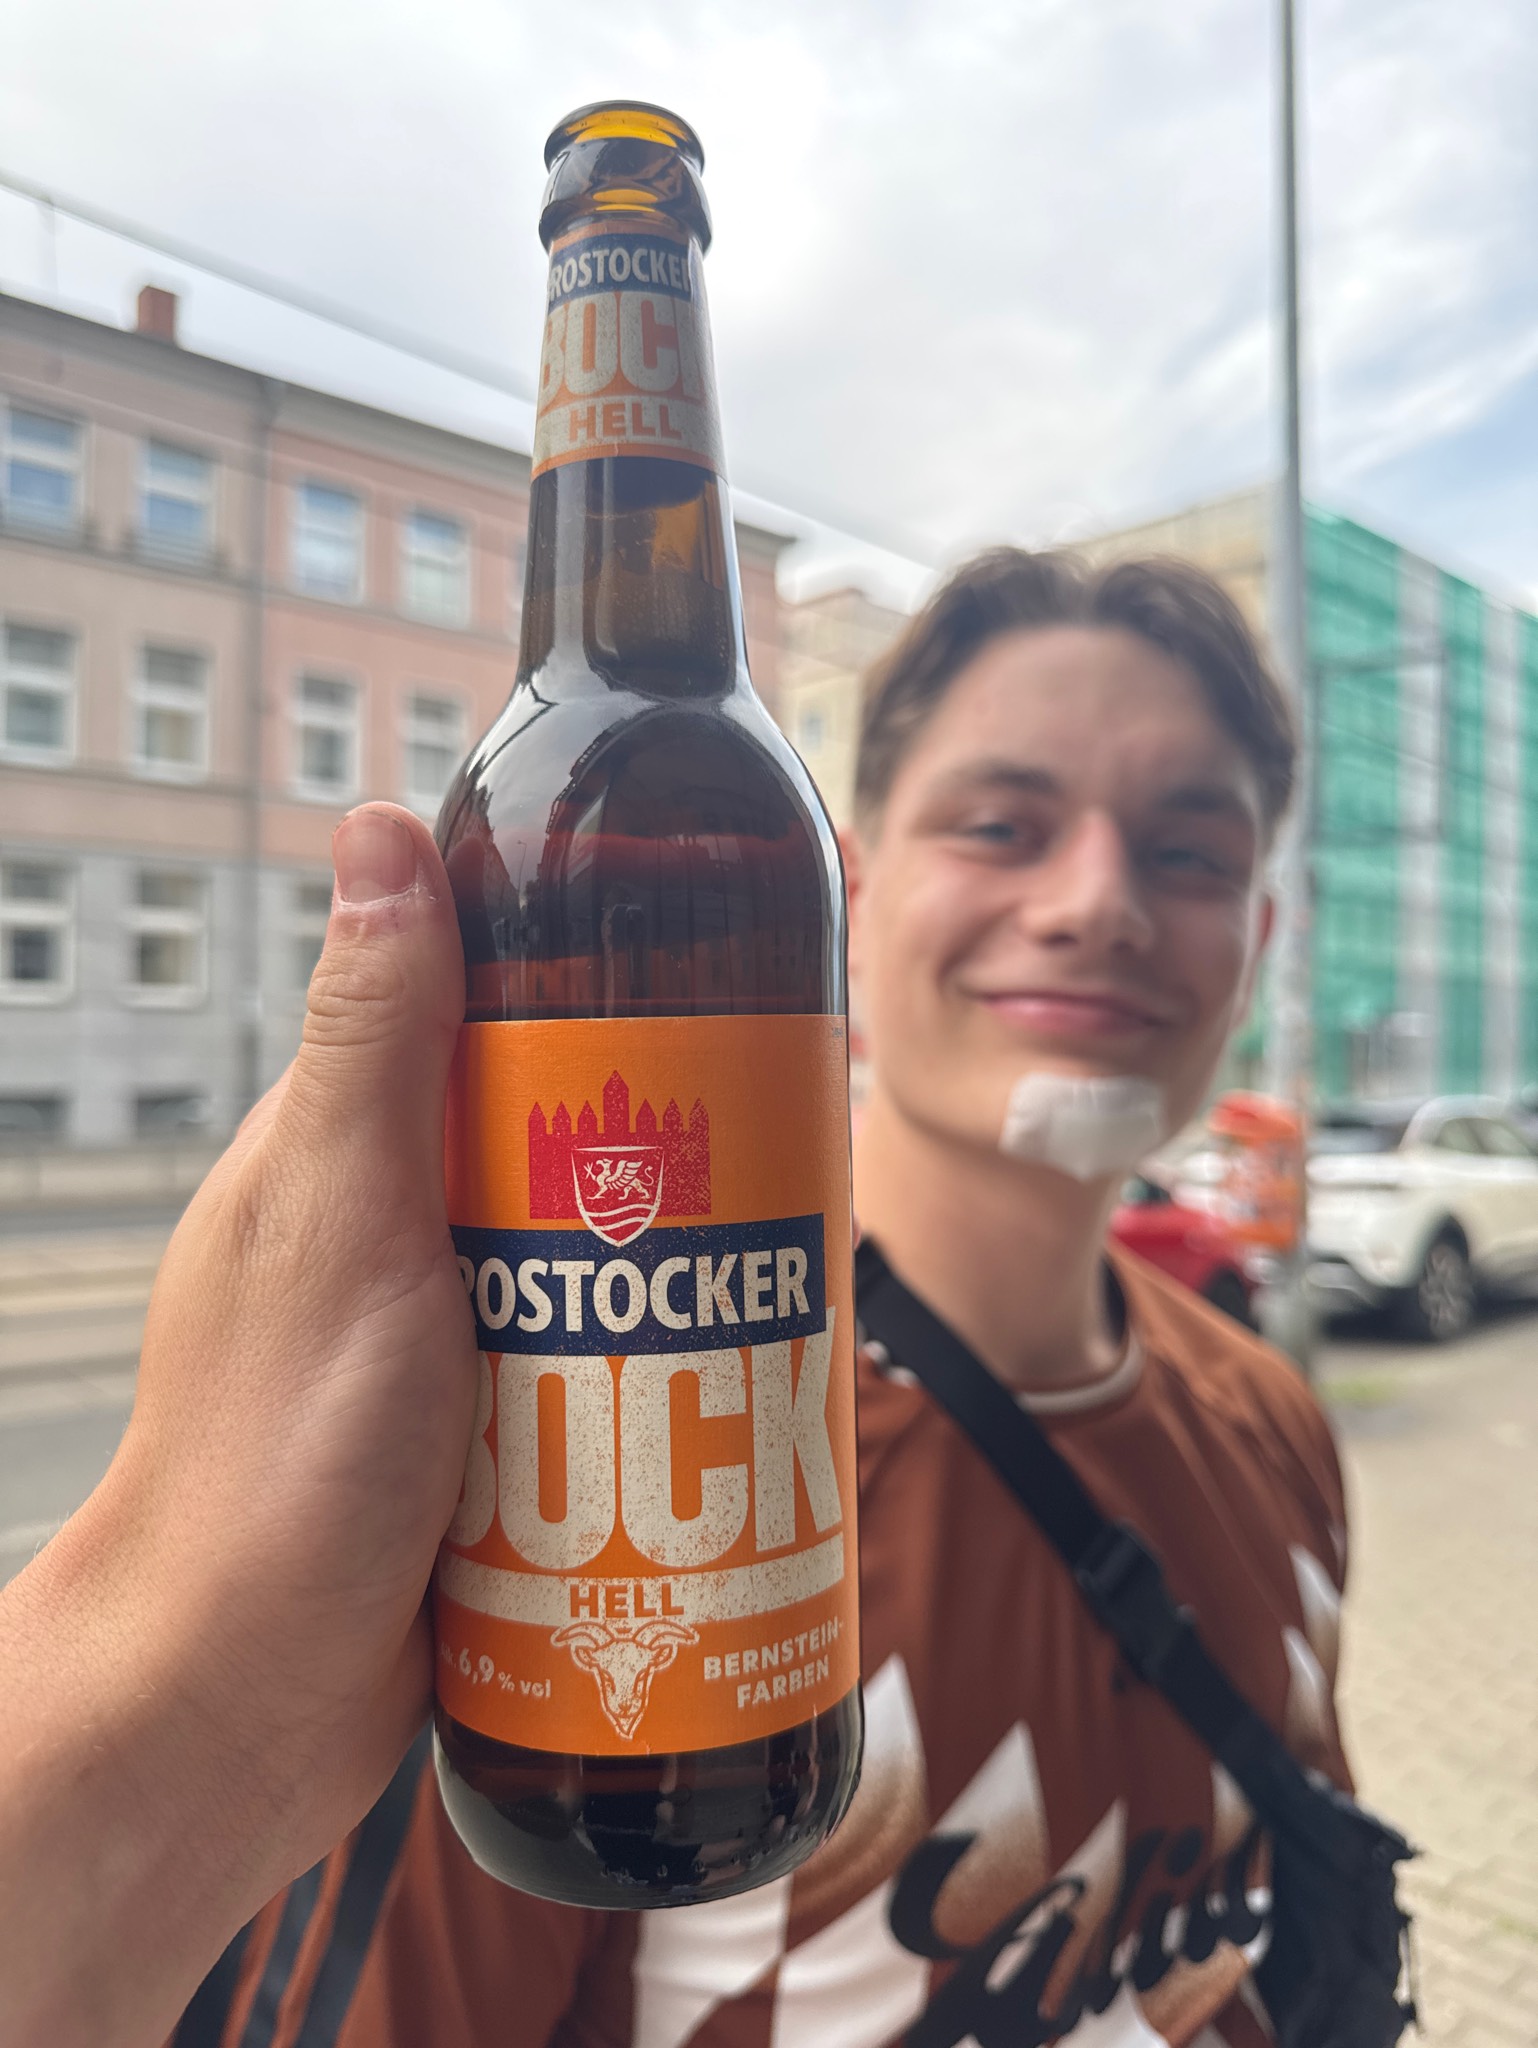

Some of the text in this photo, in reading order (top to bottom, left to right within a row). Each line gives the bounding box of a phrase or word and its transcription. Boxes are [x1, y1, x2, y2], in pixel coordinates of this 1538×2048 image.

[568, 402, 682, 442] HELL
[569, 1583, 685, 1619] HELL
[459, 1647, 495, 1685] 6,9
[499, 1671, 515, 1692] %
[520, 1678, 551, 1698] vol
[704, 1615, 844, 1681] BERNSTEIN-
[737, 1654, 829, 1709] FARBEN
